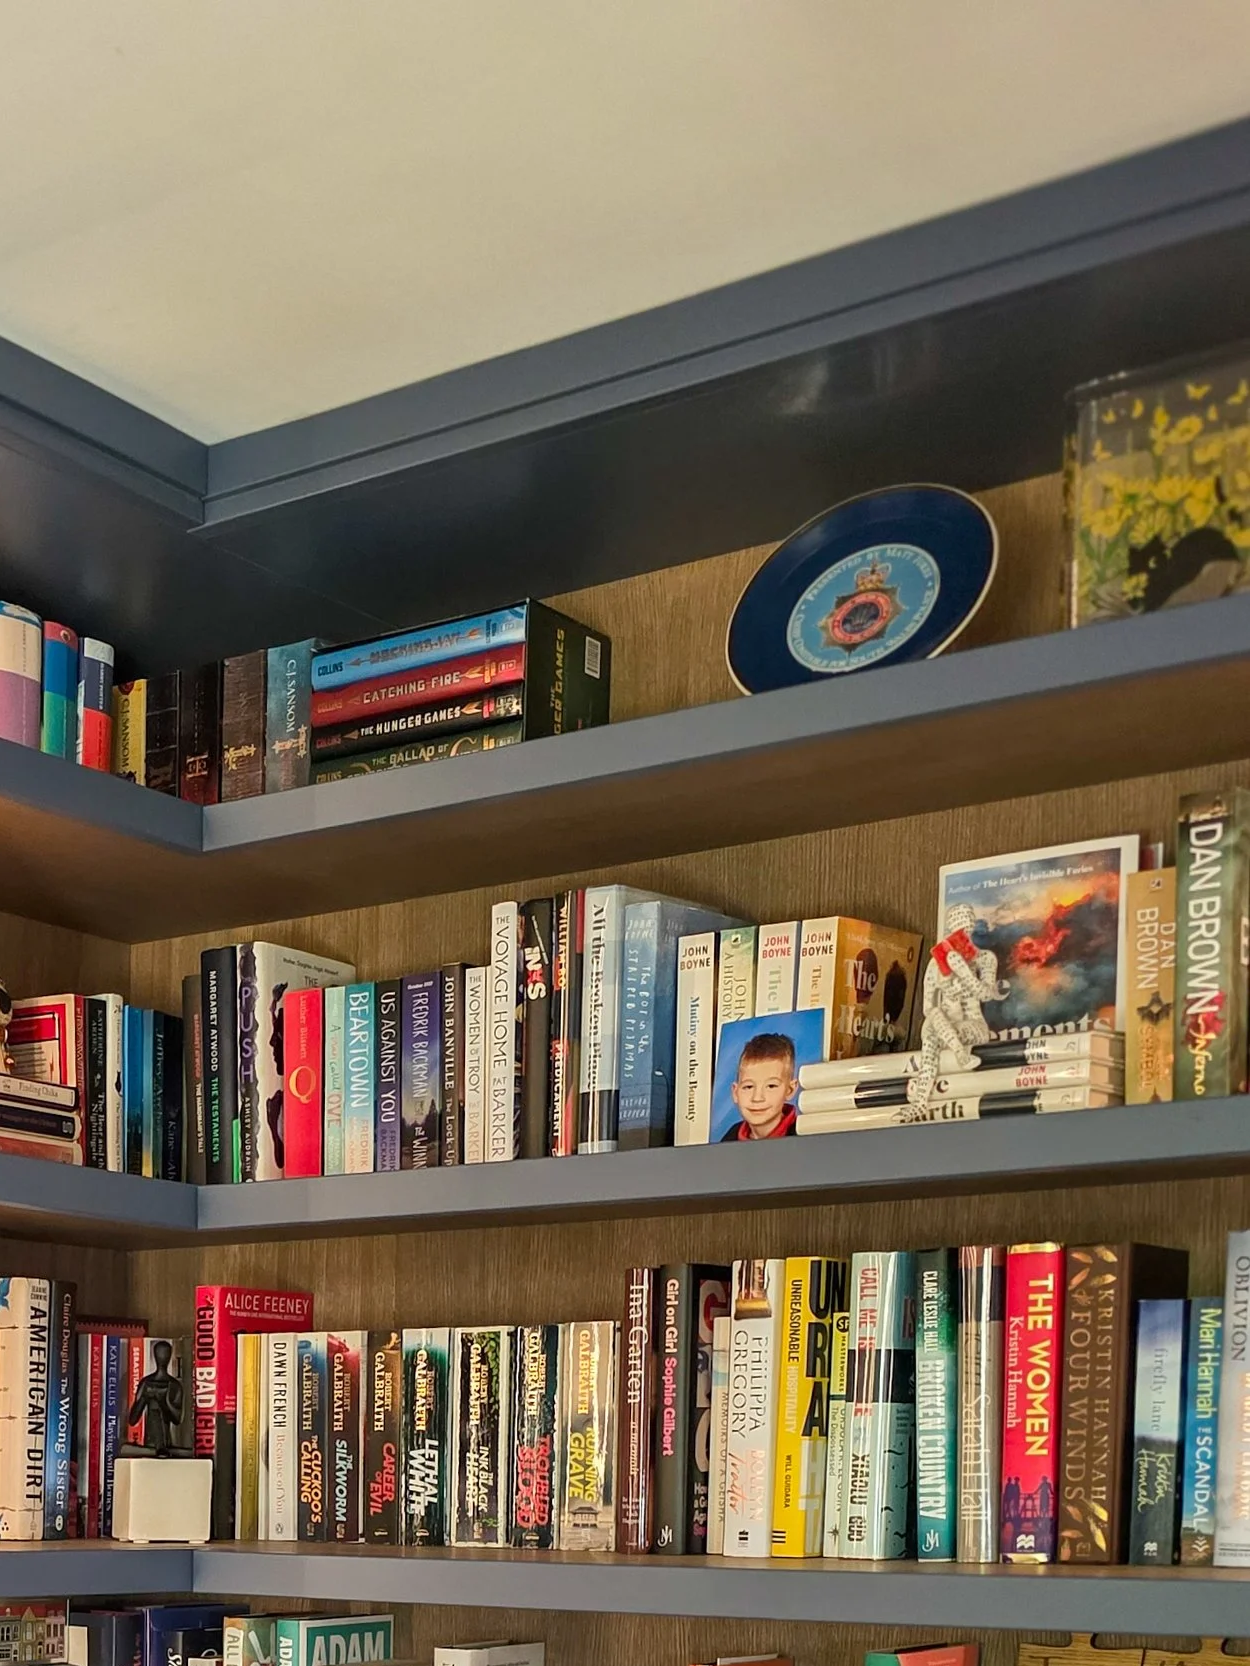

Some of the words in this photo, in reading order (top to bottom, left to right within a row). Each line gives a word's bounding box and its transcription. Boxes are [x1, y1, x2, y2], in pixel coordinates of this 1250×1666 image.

[317, 661, 344, 677] COLLINS
[363, 678, 426, 704] CATCHING
[431, 671, 462, 689] FIRE
[375, 712, 424, 735] HUNGER
[424, 705, 462, 724] GAMES
[389, 744, 435, 766] BALLAD
[1189, 815, 1223, 892] DAN
[493, 924, 511, 1005] VOYAGE
[679, 957, 711, 971] BOYNE
[681, 944, 710, 958] JOHN
[761, 947, 793, 960] BOYNE
[763, 935, 791, 948] JOHN
[801, 944, 835, 957] BOYNE
[803, 931, 833, 945] JOHN
[1136, 907, 1160, 990] BROWN
[1159, 922, 1176, 969] DAN
[1186, 897, 1221, 1014] BROWN
[380, 990, 396, 1014] US
[412, 990, 430, 1038] FREDRIK
[444, 976, 454, 1014] JOHN
[468, 985, 481, 1046] WOMEN
[210, 1028, 218, 1072] ATWOOD
[241, 986, 254, 1083] PUSH
[348, 991, 371, 1109] BEARTOWN
[380, 1019, 397, 1084] AGAINST
[444, 1017, 455, 1091] BANVILLE
[492, 1010, 509, 1069] HOME
[412, 1039, 430, 1100] BACKMAN
[468, 1056, 480, 1094] TROY
[380, 1090, 397, 1123] YOU
[491, 1087, 506, 1158] BARKER
[225, 1292, 260, 1311] ALICE
[264, 1295, 310, 1315] FEENEY
[787, 1279, 803, 1363] UNREASONABLE
[1028, 1273, 1054, 1331] THE
[196, 1306, 216, 1361] GOOD
[273, 1342, 287, 1377] DAWN
[1068, 1308, 1091, 1393] FOUR
[28, 1305, 48, 1437] AMERICAN
[195, 1366, 217, 1408] BAD
[732, 1330, 750, 1439] GREGORY
[917, 1359, 945, 1432] BROKEN
[1006, 1371, 1024, 1429] Hannah
[1024, 1340, 1052, 1456] WOMEN
[1195, 1351, 1220, 1420] Hannah
[54, 1396, 70, 1456] Wrong
[273, 1383, 287, 1428] FRENCH
[25, 1447, 44, 1503] DIRT
[300, 1440, 312, 1504] CALLING
[382, 1442, 396, 1502] CAREER
[569, 1432, 585, 1499] GRAVE
[916, 1434, 947, 1521] COUNTRY
[1063, 1401, 1089, 1502] WINDS
[55, 1459, 68, 1509] Sister
[369, 1481, 382, 1516] EVIL
[1192, 1434, 1212, 1533] SCANDAL
